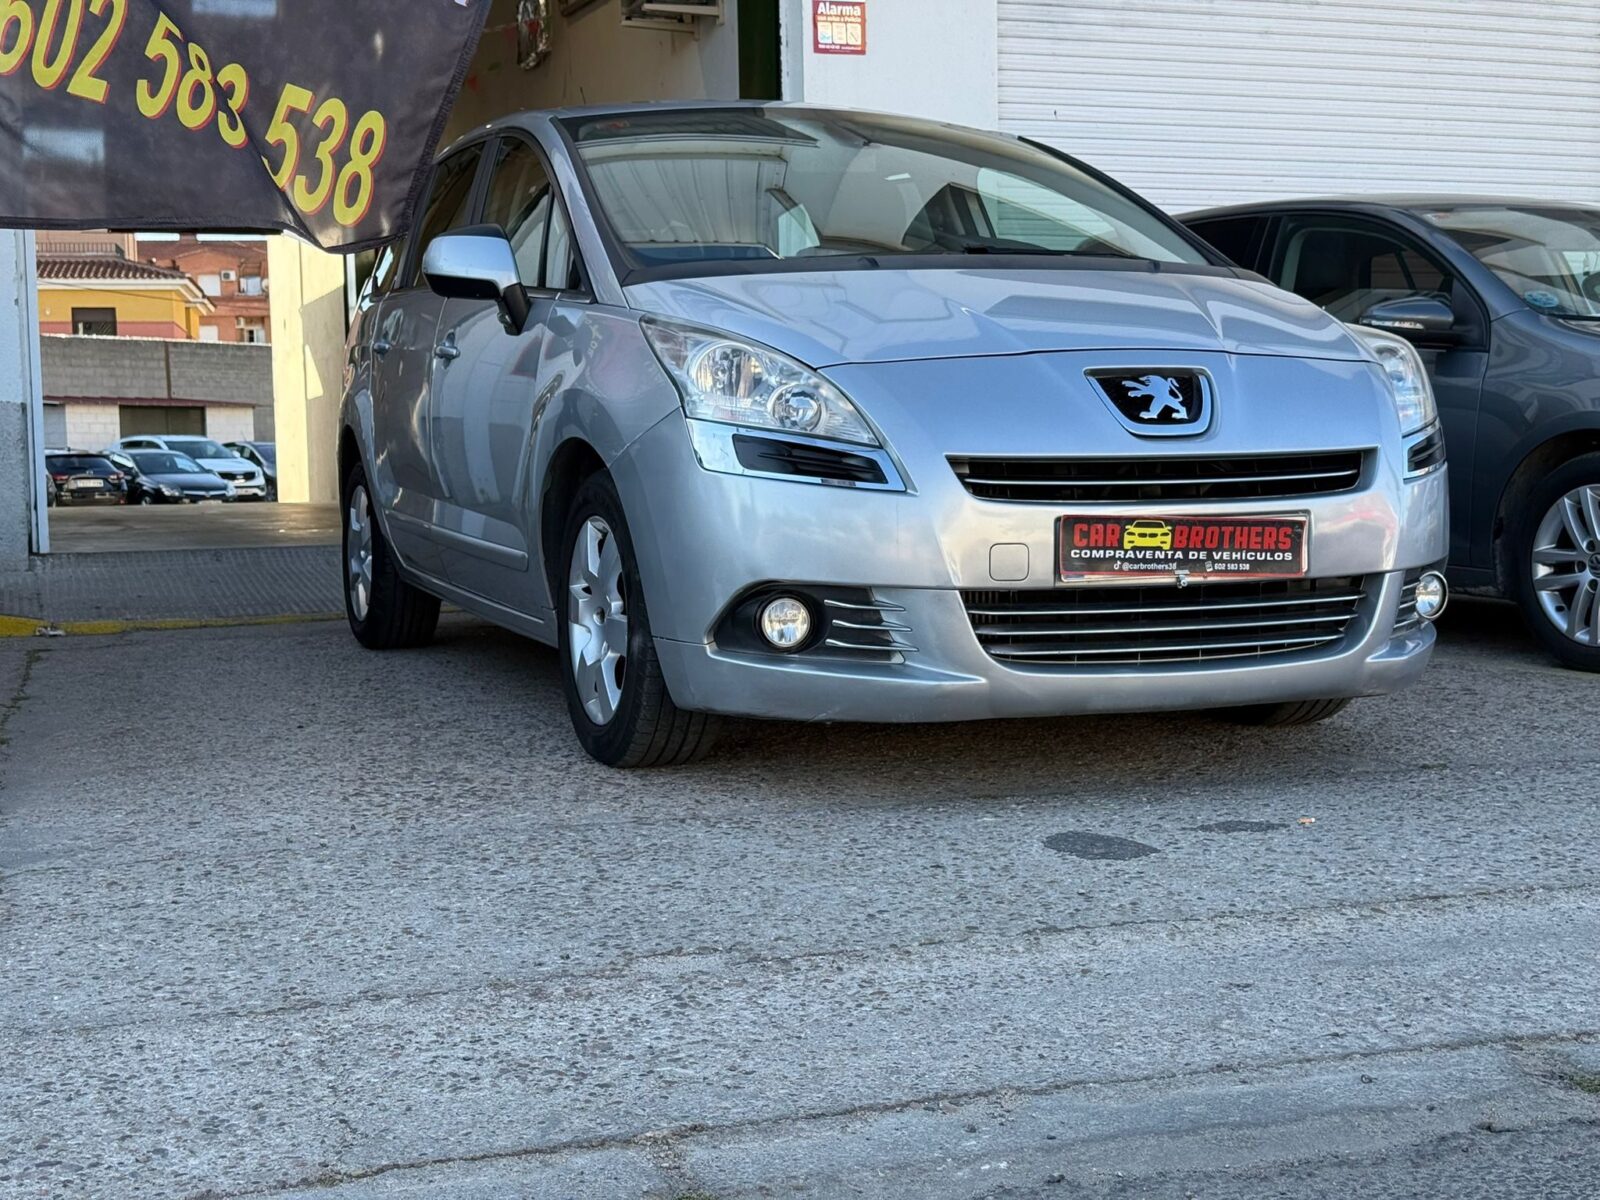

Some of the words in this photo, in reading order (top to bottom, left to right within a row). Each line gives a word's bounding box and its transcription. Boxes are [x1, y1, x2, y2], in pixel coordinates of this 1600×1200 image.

[817, 1, 862, 16] Alarma
[0, 0, 128, 104] 602
[136, 11, 249, 148] 583
[261, 83, 387, 227] 538
[1073, 523, 1120, 548] CAR
[1174, 525, 1293, 549] BROTHERS
[1070, 549, 1182, 560] COMPRAVENTA
[1188, 550, 1207, 560] DE
[1213, 549, 1293, 561] VEHÍCULOS
